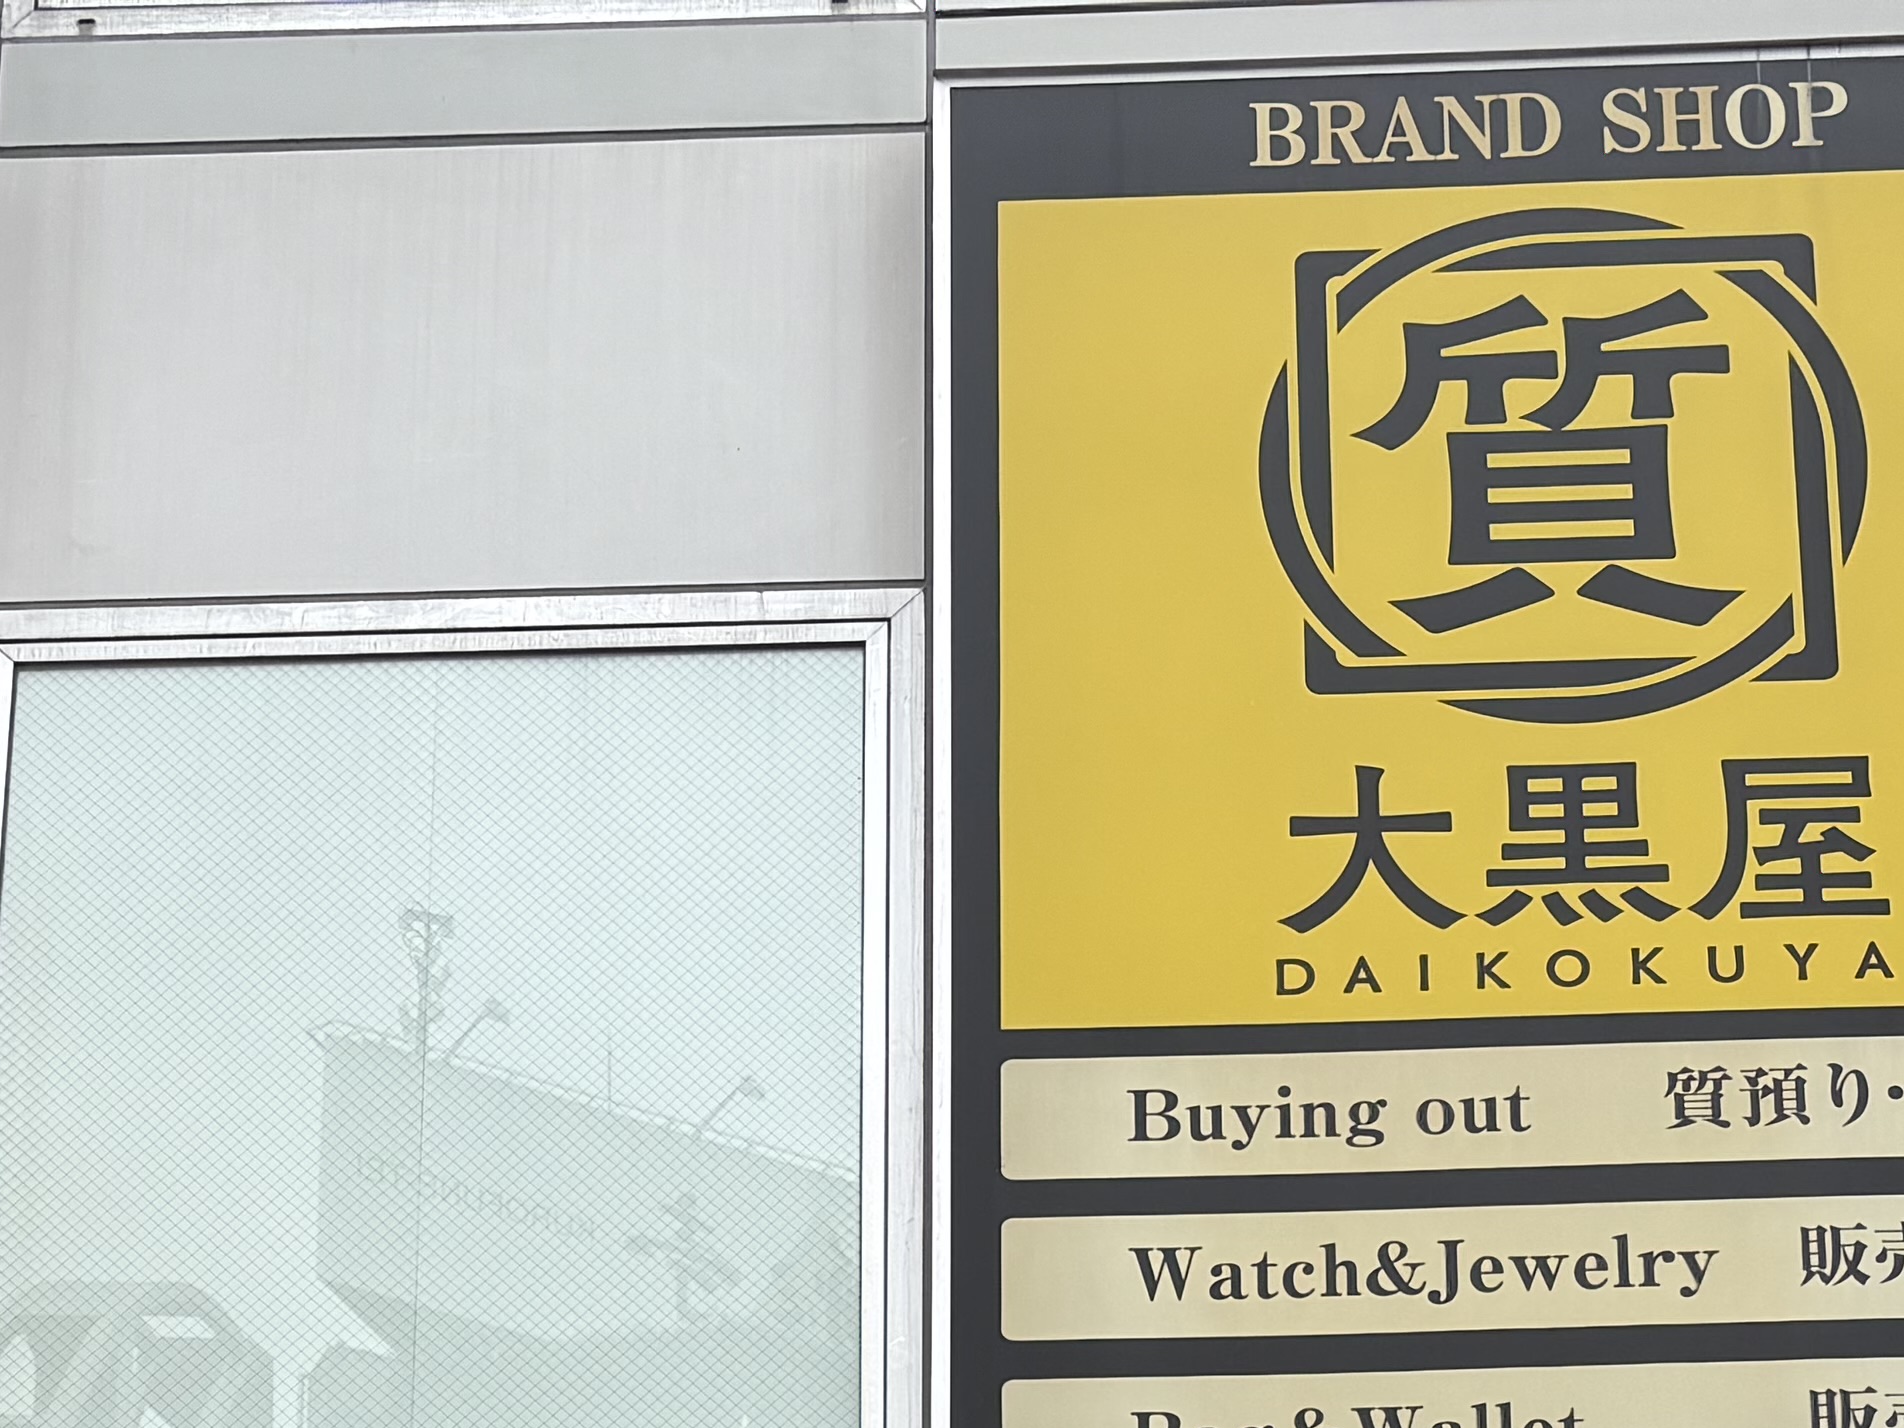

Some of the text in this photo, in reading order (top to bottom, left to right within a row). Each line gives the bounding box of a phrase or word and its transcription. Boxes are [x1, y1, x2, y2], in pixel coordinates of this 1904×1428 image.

[1250, 80, 1850, 168] BRAND SHOP
[1351, 288, 1731, 634] 質
[1278, 755, 1892, 935] 大黒屋
[1275, 939, 1896, 998] DAIKOKUYA
[1126, 1082, 1532, 1150] Buying out
[1127, 1231, 1721, 1307] Watch&Jewelry
